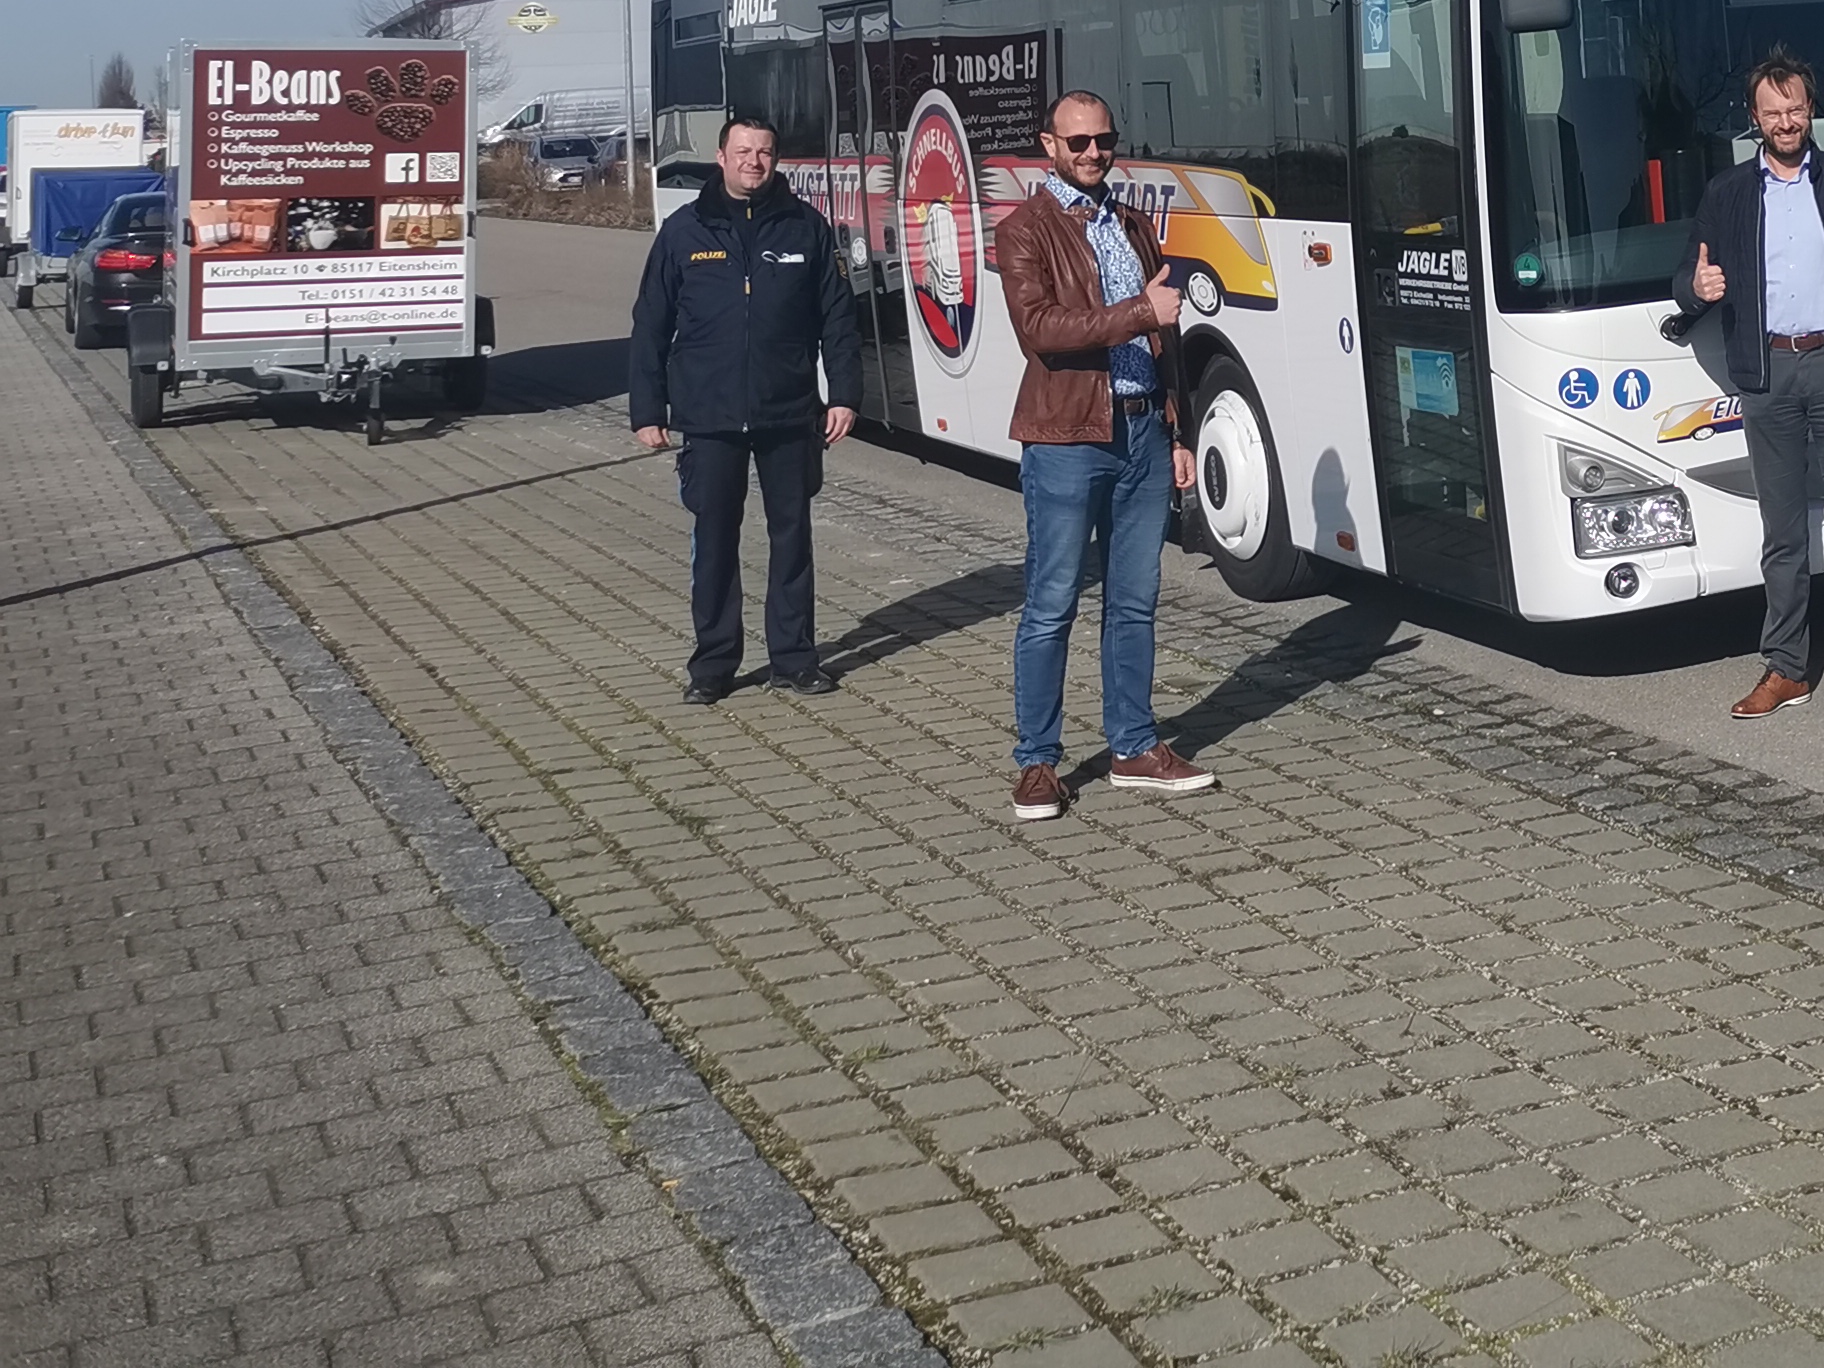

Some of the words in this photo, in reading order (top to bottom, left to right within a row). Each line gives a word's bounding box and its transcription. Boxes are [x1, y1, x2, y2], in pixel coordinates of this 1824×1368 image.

[221, 110, 320, 123] Gourmetkaffee
[221, 126, 279, 139] Espresso
[220, 141, 304, 155] Kaffeegenuss
[304, 141, 374, 155] Workshop
[220, 158, 284, 172] Upcycling
[286, 157, 346, 169] Produkte
[348, 158, 371, 169] aus
[909, 128, 965, 194] SCHNELLBUS
[220, 173, 304, 186] Kaffeesäcken
[211, 266, 287, 279] Kirchplatz
[293, 264, 309, 275] 10
[331, 262, 374, 274] 85117
[379, 259, 458, 272] Eitensheim
[1398, 249, 1450, 276] JÄGLE
[331, 288, 364, 300] 0151
[379, 287, 395, 298] 42
[400, 286, 415, 297] 31
[421, 285, 437, 296] 54
[442, 284, 458, 296] 48
